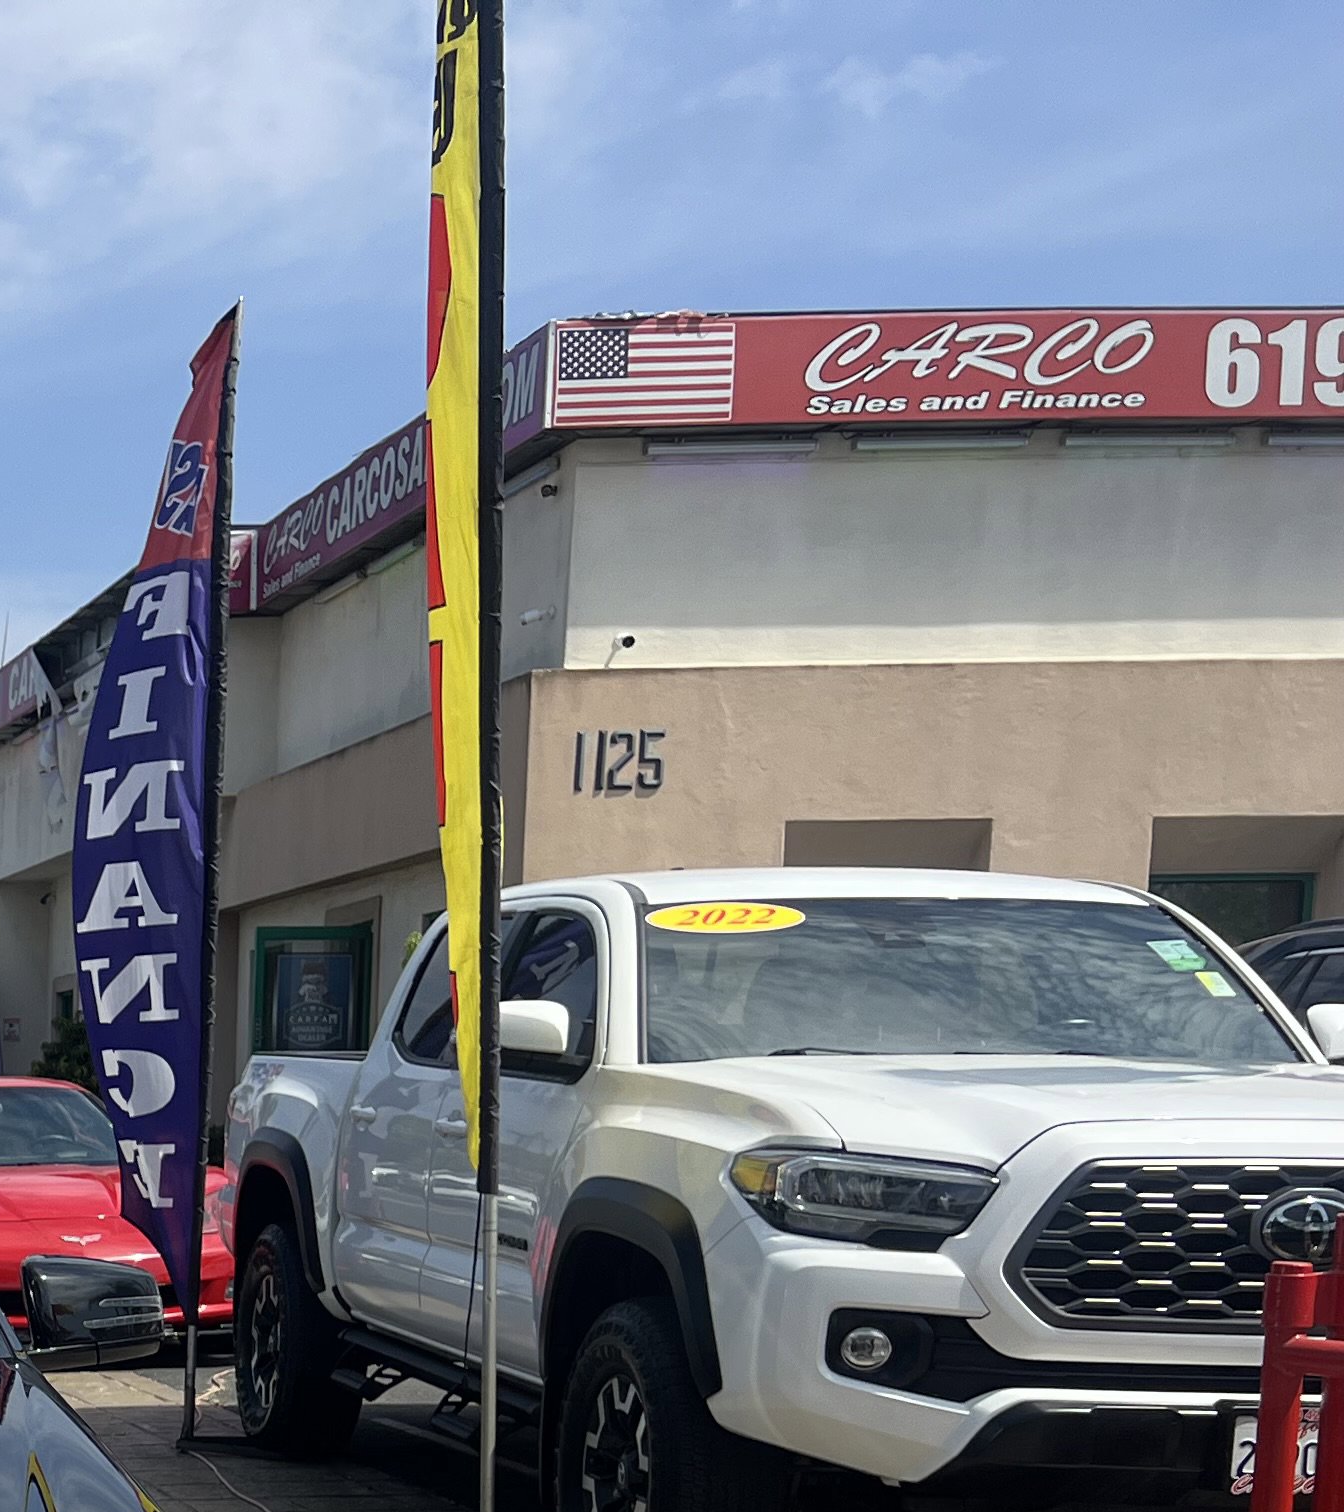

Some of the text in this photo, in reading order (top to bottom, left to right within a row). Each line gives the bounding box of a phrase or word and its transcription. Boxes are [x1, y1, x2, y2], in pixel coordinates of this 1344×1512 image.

[805, 318, 1154, 392] CARCO
[806, 390, 1146, 414] Sales and Finance
[264, 492, 325, 575] CARCO
[295, 552, 321, 583] Finance
[574, 729, 666, 792] 1125
[675, 908, 777, 926] 2022
